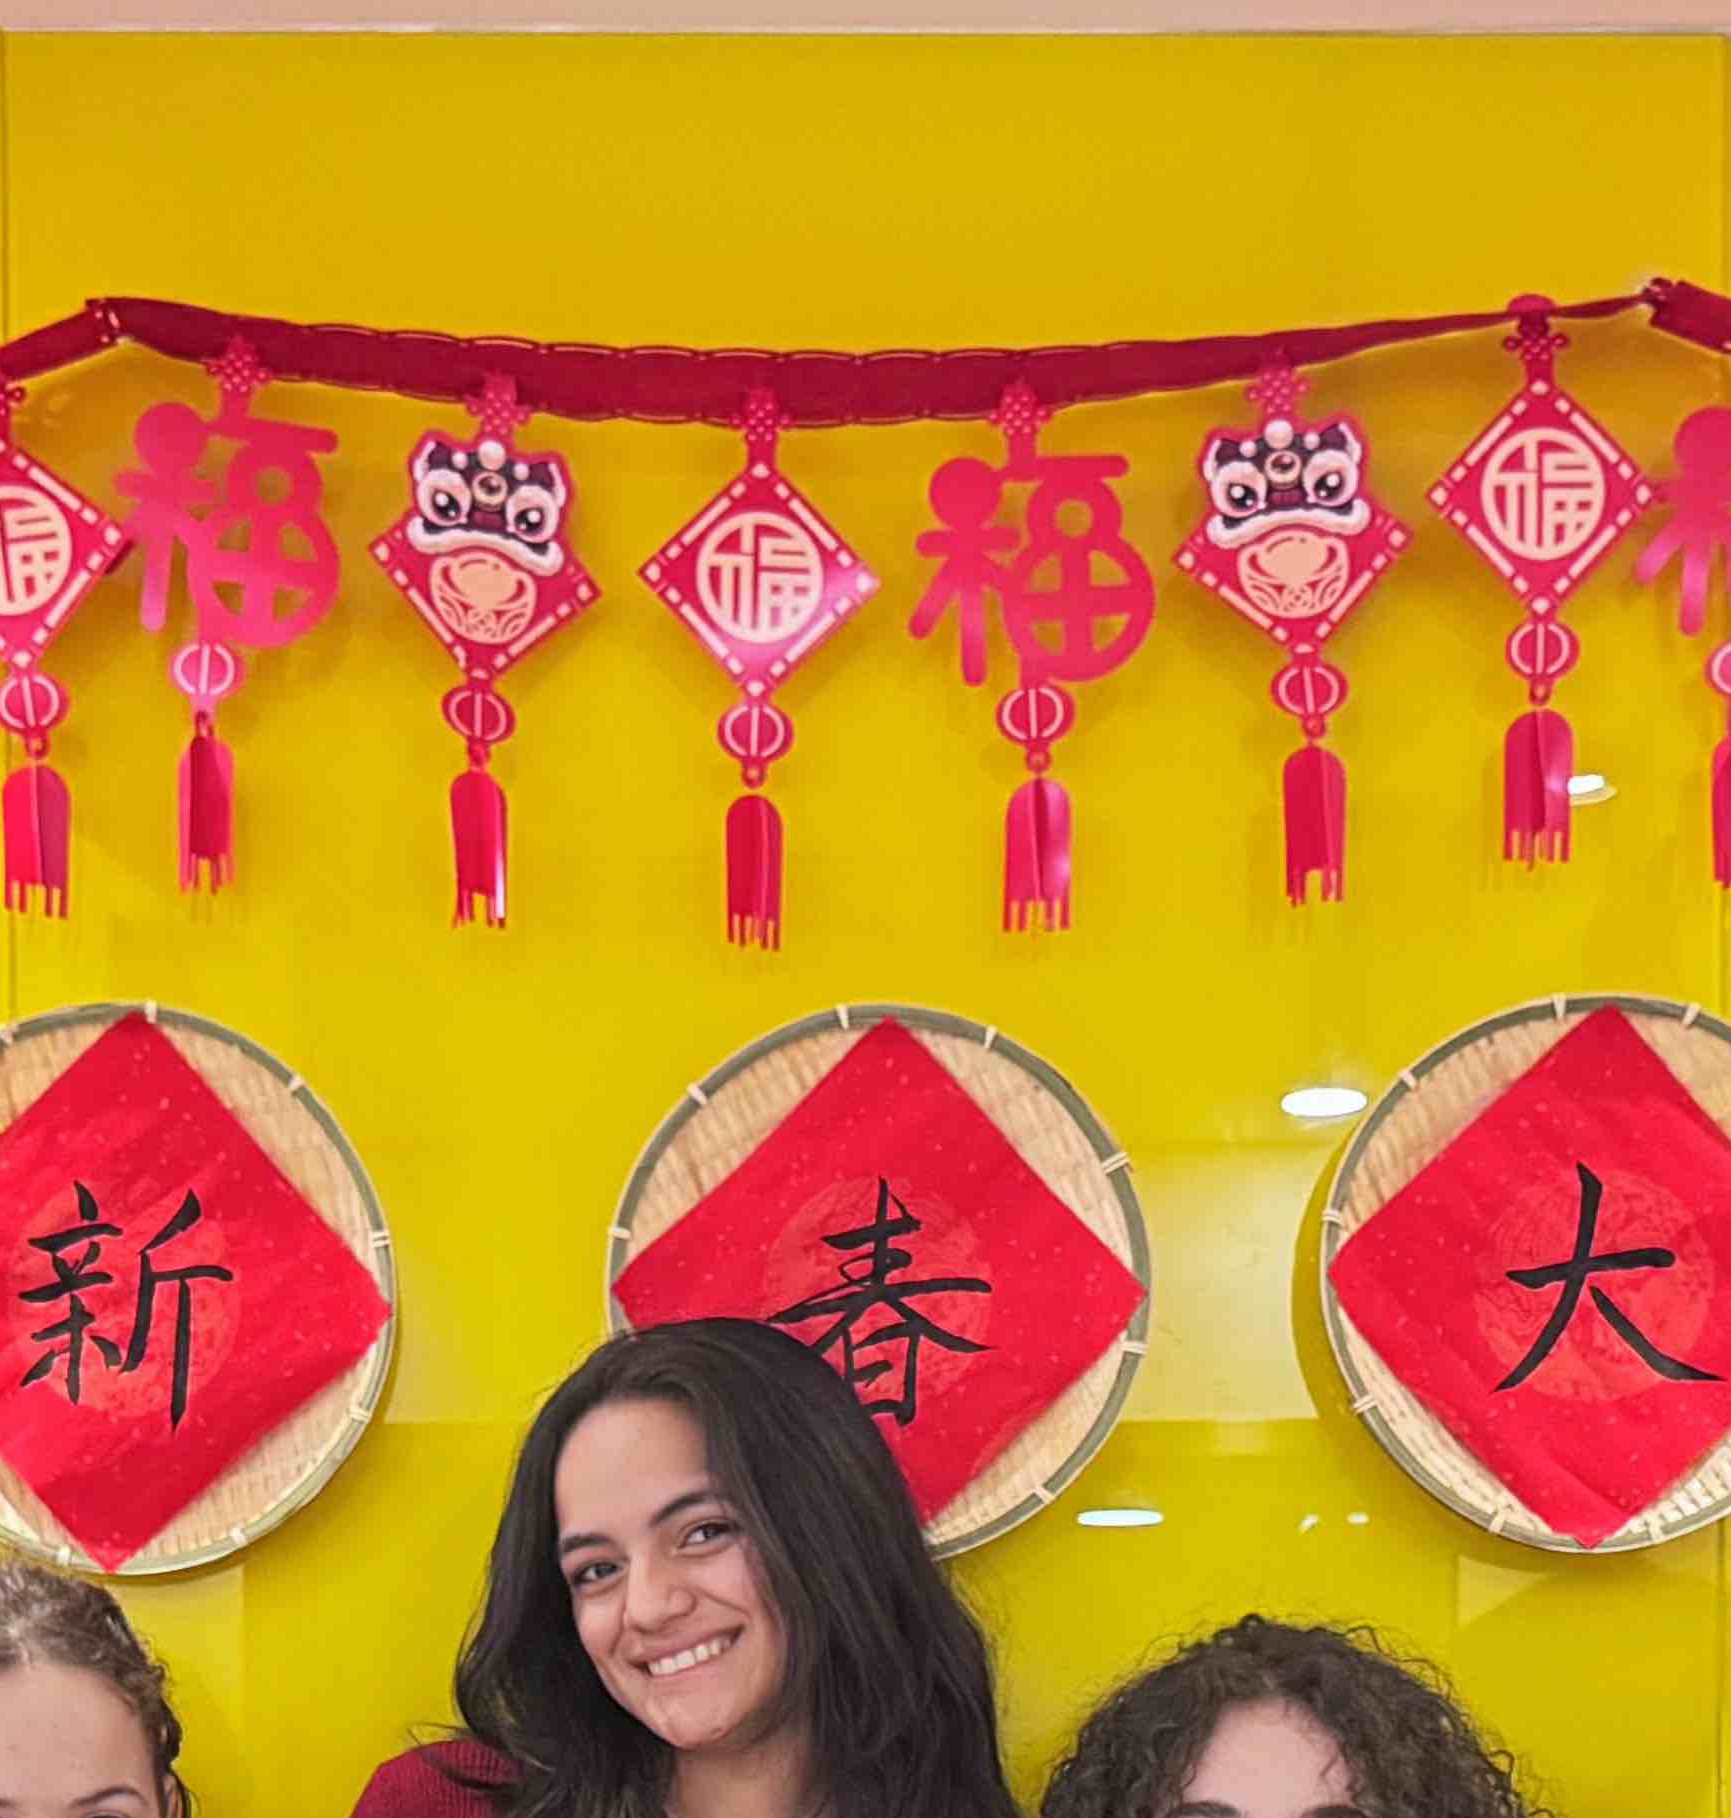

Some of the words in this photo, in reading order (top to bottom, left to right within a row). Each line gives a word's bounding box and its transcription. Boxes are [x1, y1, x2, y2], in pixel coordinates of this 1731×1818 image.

[114, 402, 341, 650] 福
[696, 511, 824, 644] 福
[908, 454, 1155, 686] 福
[1481, 425, 1606, 560] 福
[19, 1177, 234, 1431] 新
[765, 1175, 997, 1427] 春
[1489, 1160, 1727, 1394] 大
